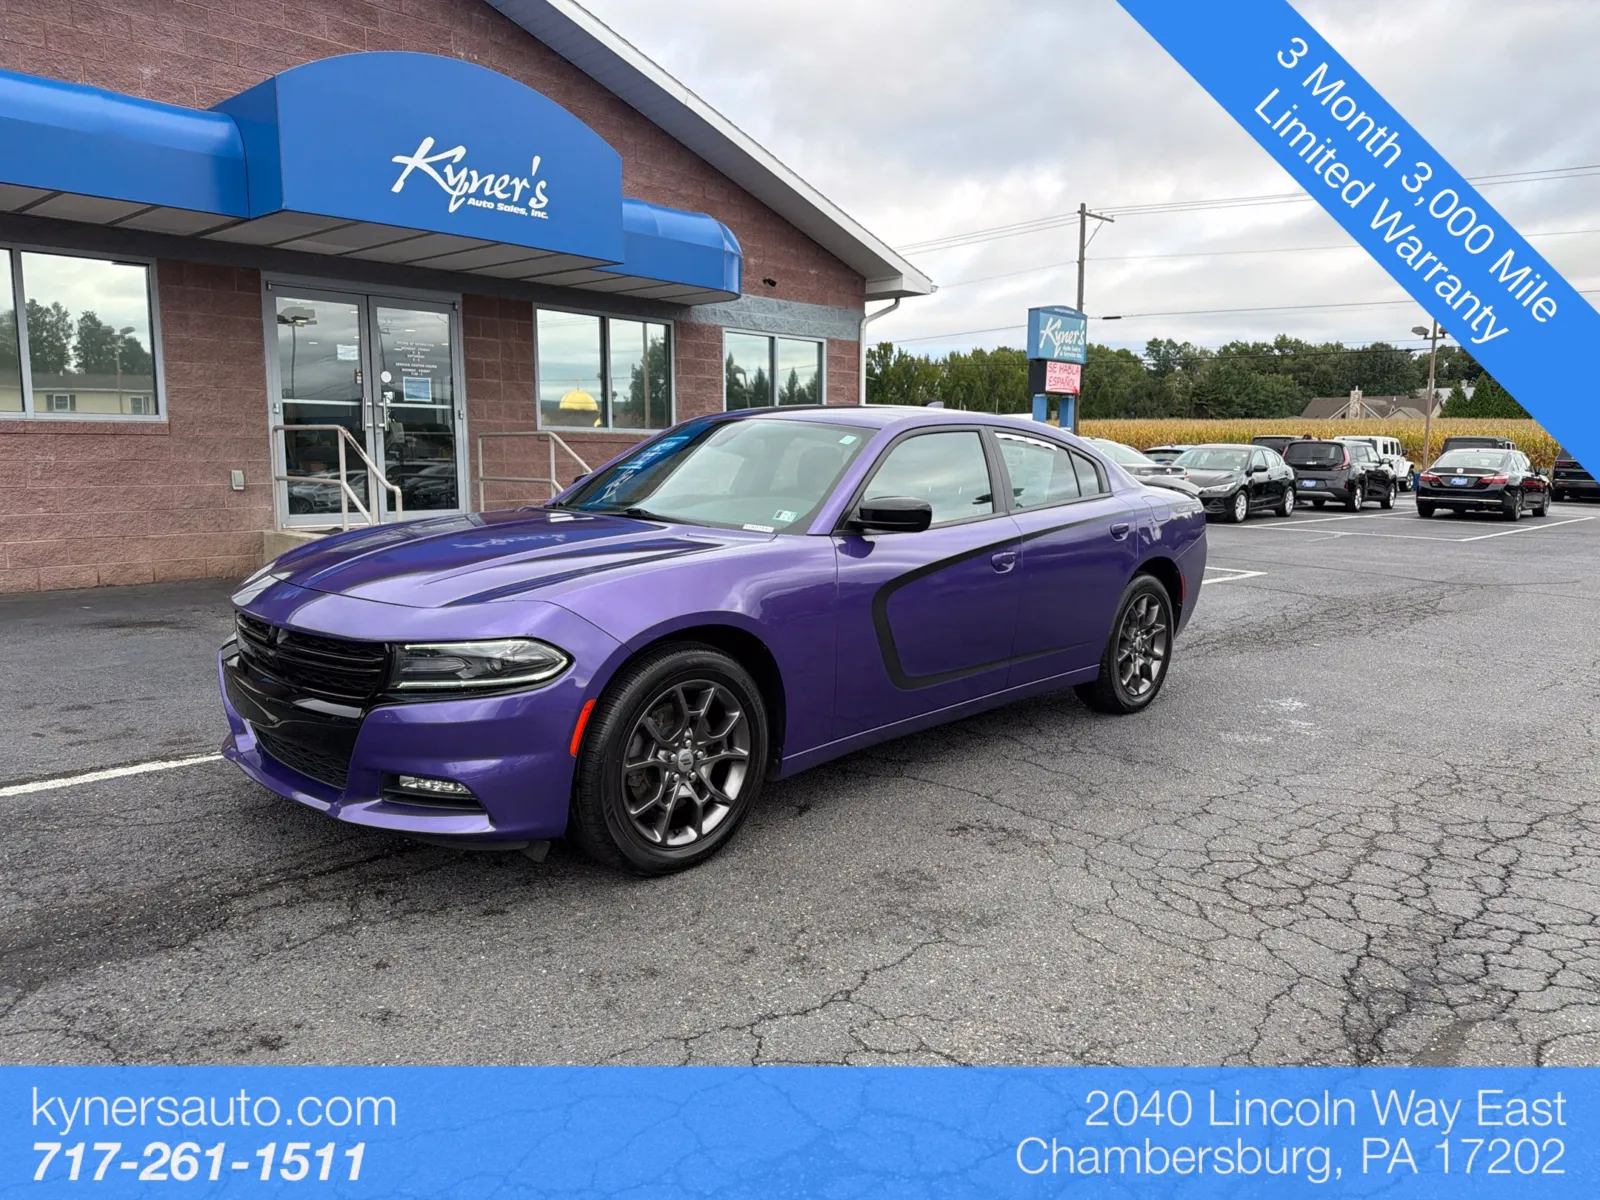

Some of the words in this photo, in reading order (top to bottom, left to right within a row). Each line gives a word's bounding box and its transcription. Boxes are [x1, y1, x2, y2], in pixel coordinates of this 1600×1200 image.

[391, 136, 549, 214] Kyner's
[467, 197, 495, 209] Auto
[496, 202, 528, 216] Sales,
[531, 208, 549, 219] Inc.
[1039, 316, 1085, 358] Kyner's
[1059, 365, 1079, 375] HABLA
